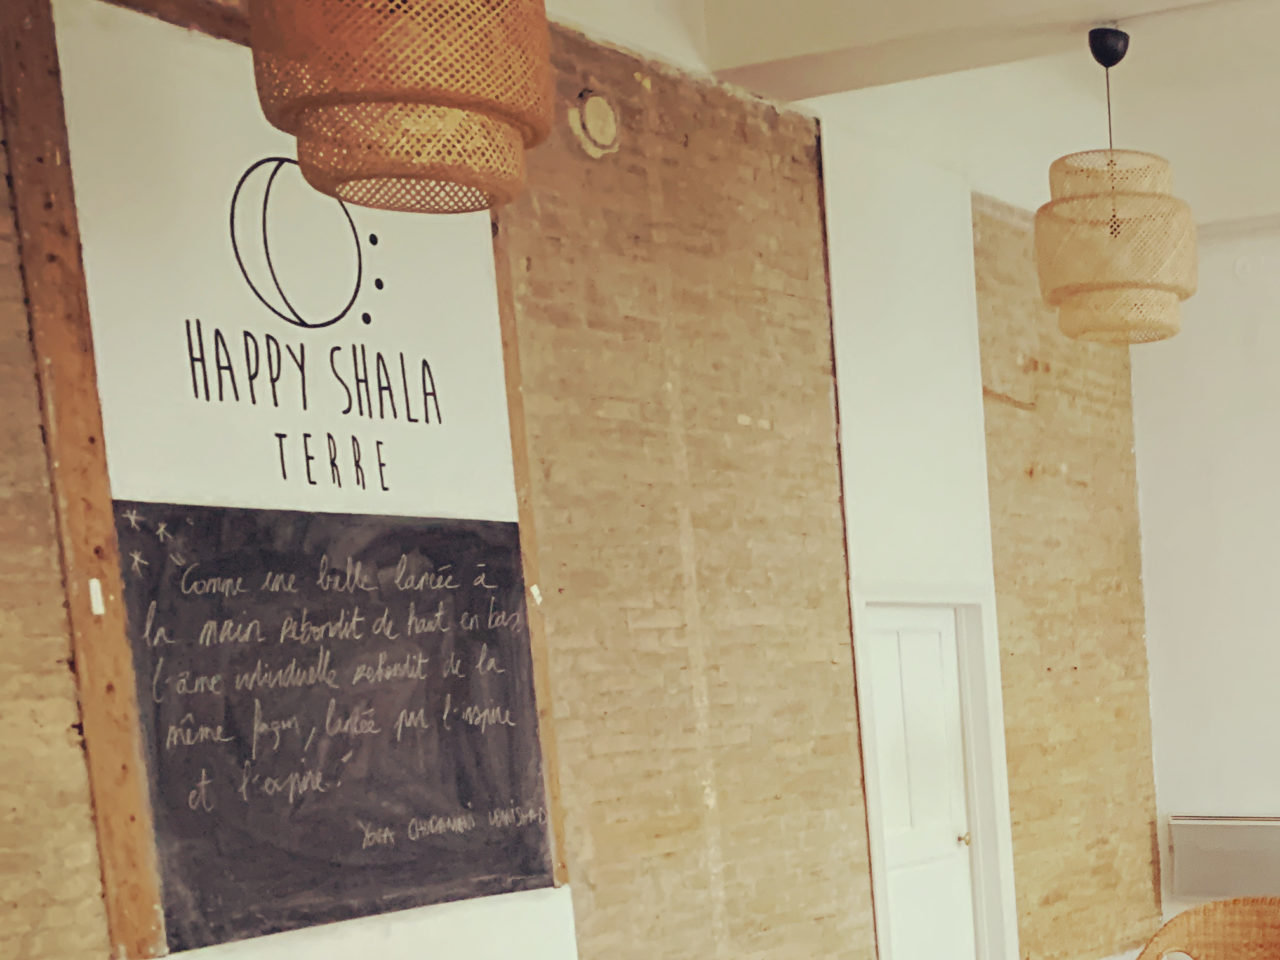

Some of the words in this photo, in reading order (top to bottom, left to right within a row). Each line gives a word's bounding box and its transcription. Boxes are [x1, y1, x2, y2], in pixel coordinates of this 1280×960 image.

[185, 319, 307, 411] HAPPY
[329, 343, 442, 424] SHALA
[274, 432, 389, 492] TERRE
[317, 554, 378, 593] balle
[200, 610, 266, 646] main
[372, 608, 400, 640] de
[408, 601, 451, 636] haut
[165, 713, 235, 749] même
[188, 768, 214, 812] et
